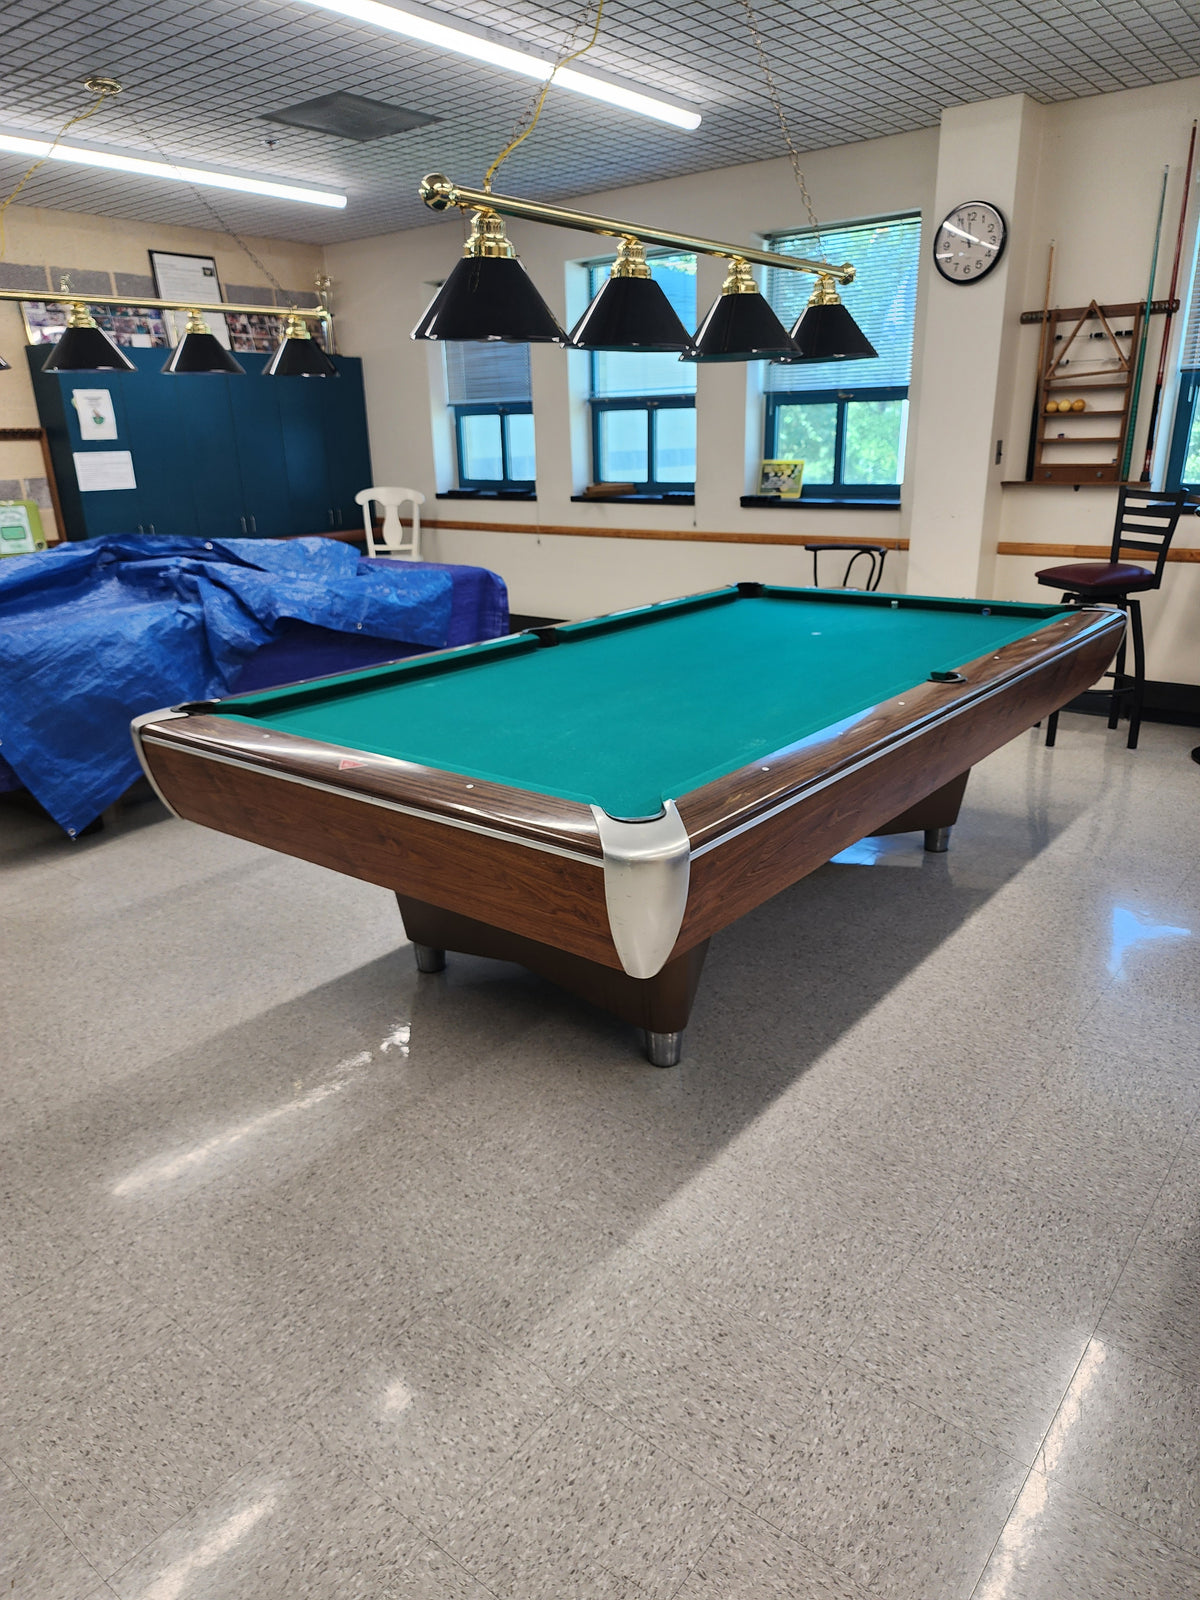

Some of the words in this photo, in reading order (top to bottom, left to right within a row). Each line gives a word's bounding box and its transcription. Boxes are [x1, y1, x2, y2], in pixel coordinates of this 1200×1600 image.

[967, 211, 977, 221] 12
[981, 215, 986, 223] 1
[987, 223, 995, 233] 2
[989, 235, 997, 245] 3
[943, 241, 950, 250] 9
[953, 262, 959, 271] 7
[963, 264, 971, 274] 6
[975, 260, 983, 269] 5
